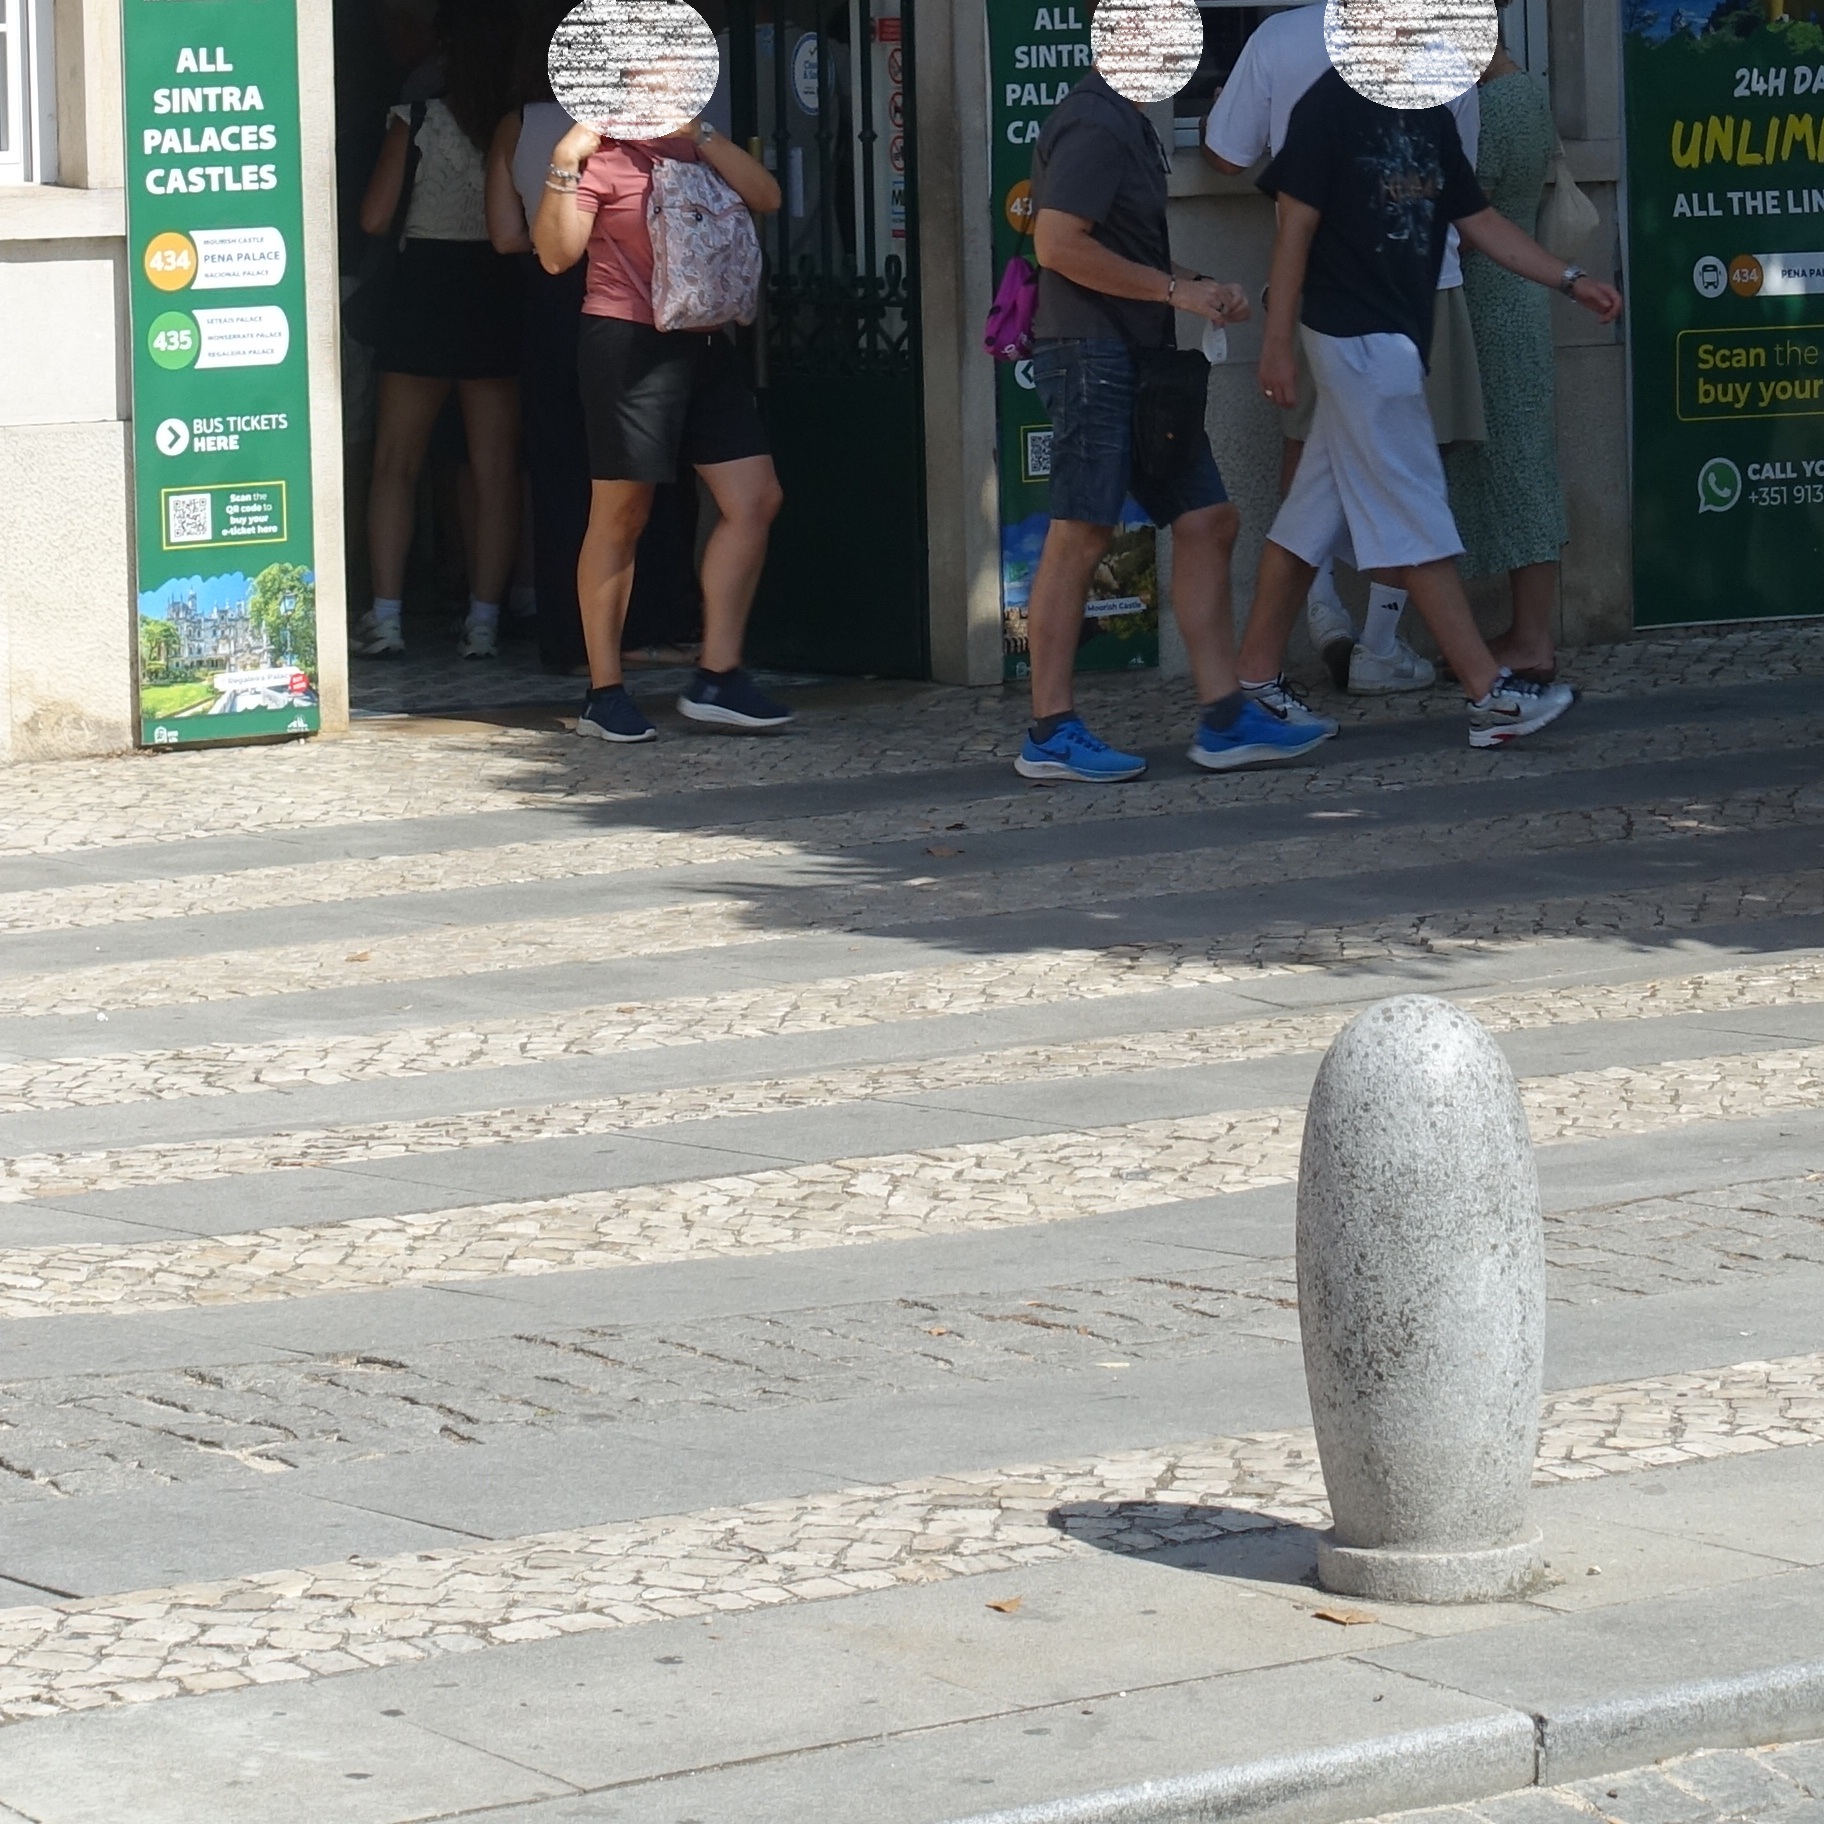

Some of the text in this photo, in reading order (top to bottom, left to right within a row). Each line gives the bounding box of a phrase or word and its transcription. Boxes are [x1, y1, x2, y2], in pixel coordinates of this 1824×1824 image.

[1035, 7, 1082, 30] ALL
[176, 47, 233, 73] ALL
[1015, 44, 1092, 69] SINTR
[1734, 66, 1785, 97] 24H
[153, 86, 264, 114] SINTRA
[1005, 83, 1069, 106] PALA
[143, 125, 277, 154] PALACES
[145, 164, 277, 194] CASTLES
[1010, 197, 1032, 215] 43
[1673, 192, 1722, 218] ALL
[1727, 190, 1779, 216] THE
[149, 249, 191, 271] 434
[204, 251, 280, 263] PENA PALACE
[1732, 269, 1759, 284] 434
[1781, 269, 1808, 279] PENA
[153, 330, 192, 351] 435
[1698, 344, 1766, 370] Scan
[1774, 339, 1819, 367] the
[1697, 378, 1750, 409] buy
[1757, 376, 1823, 407] your
[193, 413, 288, 435] BUS TICKETS
[193, 435, 240, 452] HERE
[1747, 461, 1797, 482] CALL
[230, 492, 267, 502] Scan the
[1748, 484, 1788, 506] +351
[1793, 483, 1823, 504] 913
[226, 503, 273, 515] QR code to
[230, 515, 269, 525] buy your
[221, 525, 278, 536] e-ticket here
[1119, 601, 1141, 609] Castle
